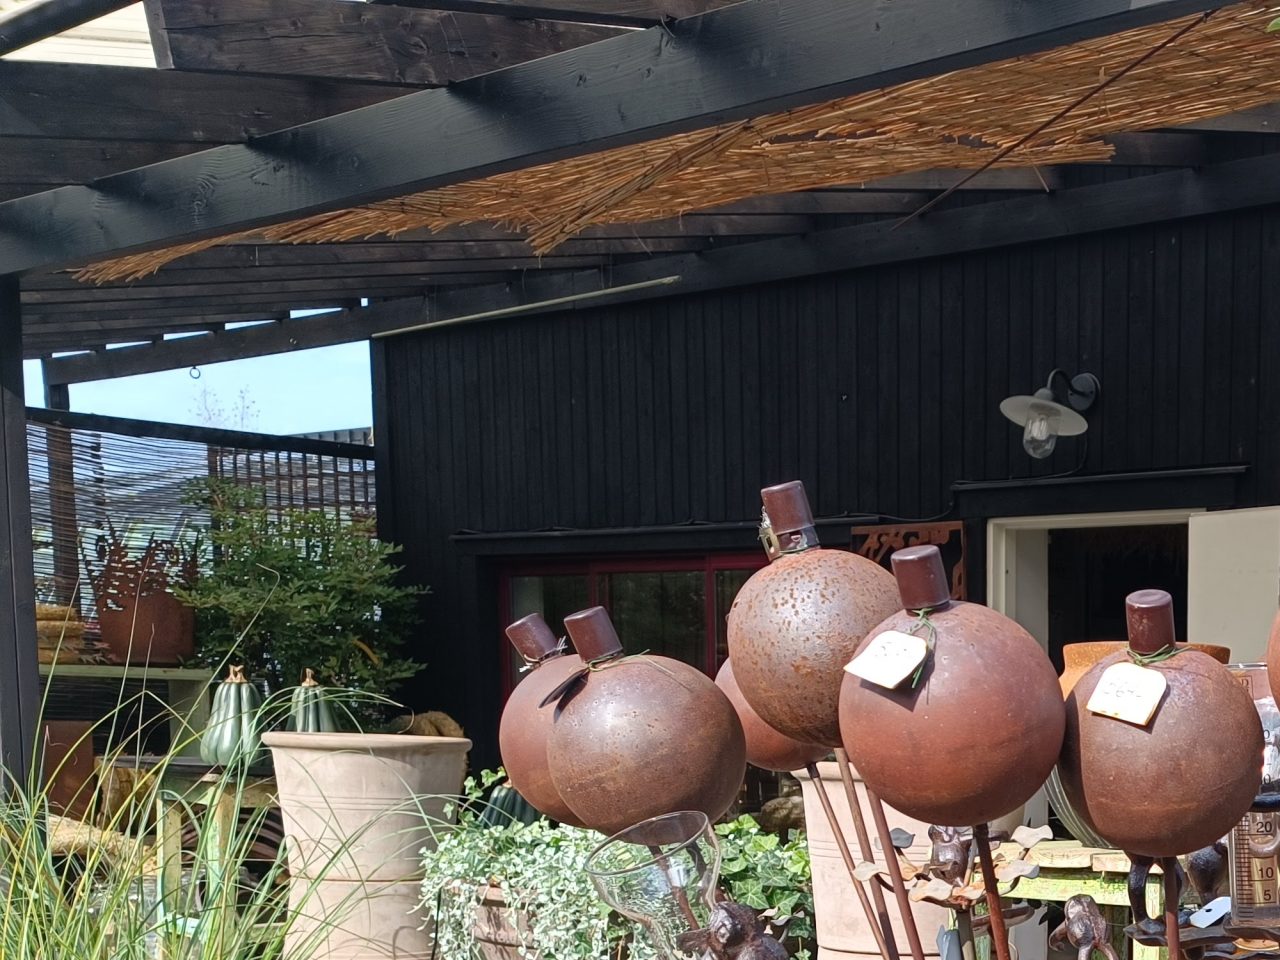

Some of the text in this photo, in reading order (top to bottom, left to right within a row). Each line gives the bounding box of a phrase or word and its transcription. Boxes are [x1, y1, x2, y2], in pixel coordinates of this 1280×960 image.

[1256, 821, 1273, 834] 20
[1258, 866, 1274, 879] 10
[1263, 889, 1272, 902] 5
